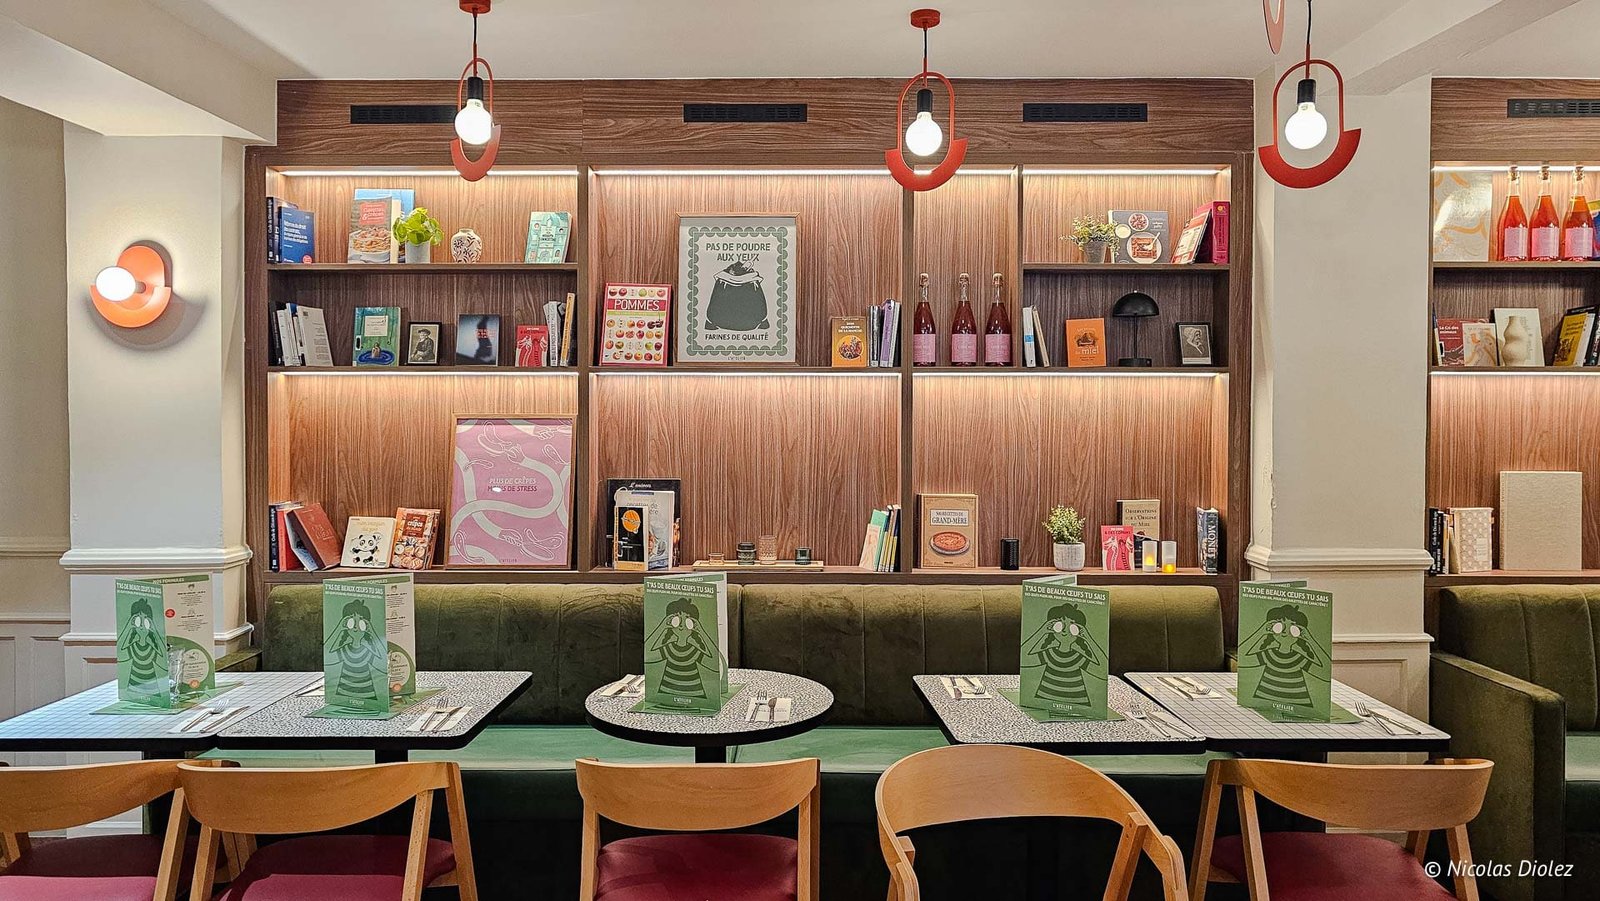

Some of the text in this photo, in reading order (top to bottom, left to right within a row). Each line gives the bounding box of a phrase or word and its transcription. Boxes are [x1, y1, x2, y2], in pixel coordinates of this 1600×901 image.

[706, 243, 771, 251] PAS DE POUDRE
[717, 253, 759, 261] AUX YEUX
[614, 299, 659, 310] POMMES
[742, 332, 768, 341] QUALITÉ
[1067, 590, 1083, 598] ŒUFS
[1094, 593, 1106, 601] SAIS
[1256, 587, 1265, 595] DE
[1266, 589, 1286, 597] BEAUX
[1287, 591, 1305, 600] ŒUFS
[1307, 593, 1315, 601] TU
[1316, 594, 1329, 602] SAIS
